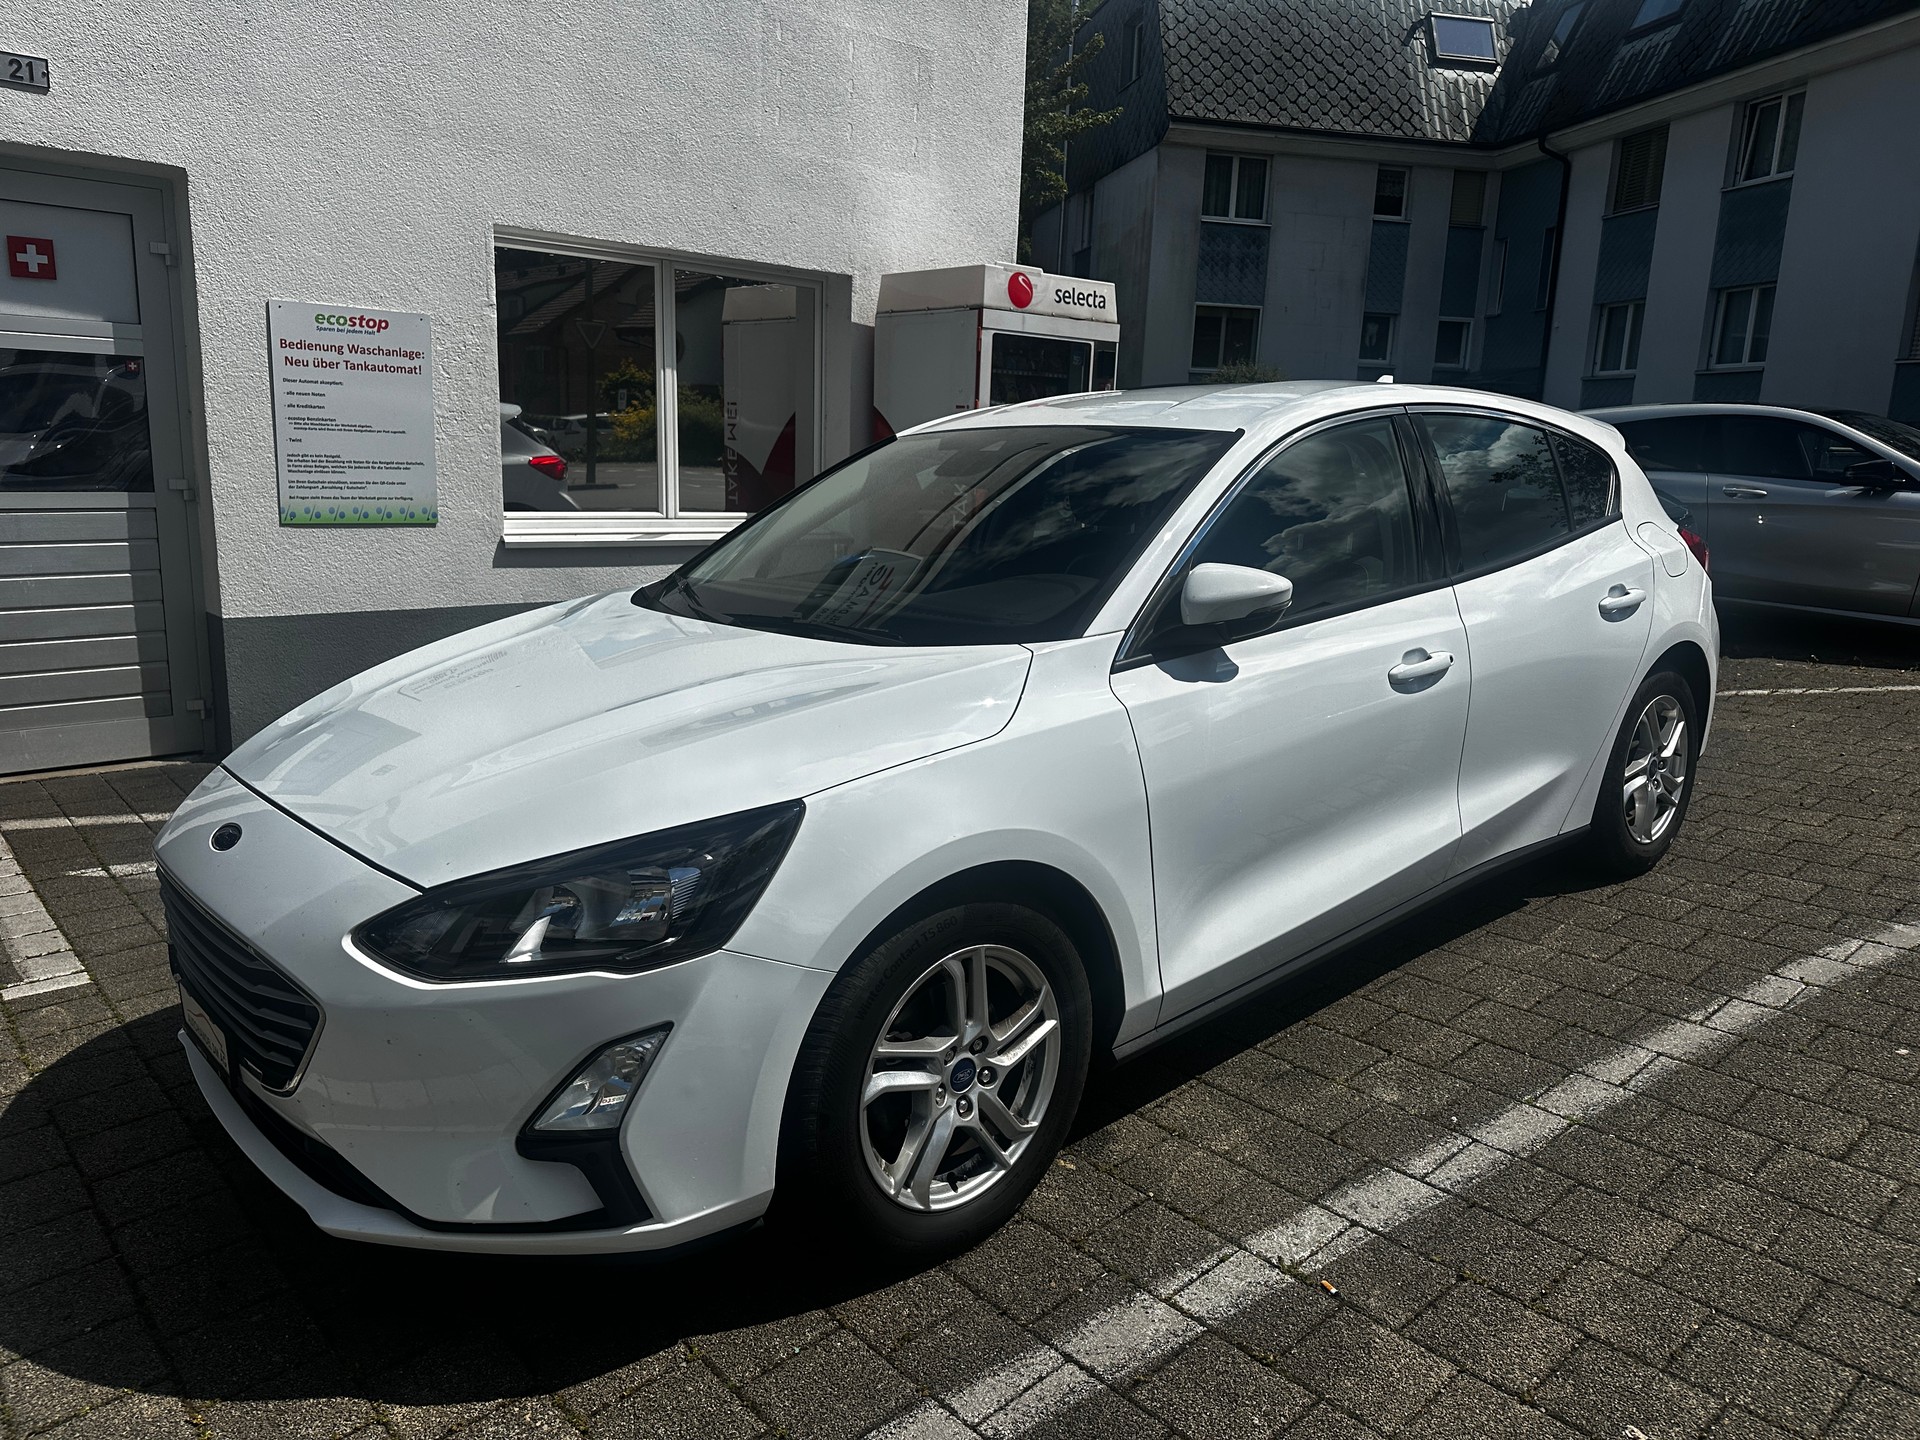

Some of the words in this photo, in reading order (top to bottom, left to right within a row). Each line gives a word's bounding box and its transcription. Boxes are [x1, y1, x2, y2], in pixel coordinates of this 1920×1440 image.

[8, 58, 34, 83] 21
[1054, 288, 1106, 309] selecta
[315, 313, 389, 333] ecostop
[280, 338, 344, 355] Bedienung
[347, 344, 425, 360] Waschanlage:
[284, 356, 309, 367] Neu
[313, 358, 340, 370] über
[343, 360, 422, 375] Tankautomat!
[921, 927, 936, 942] TS
[936, 916, 958, 933] 860
